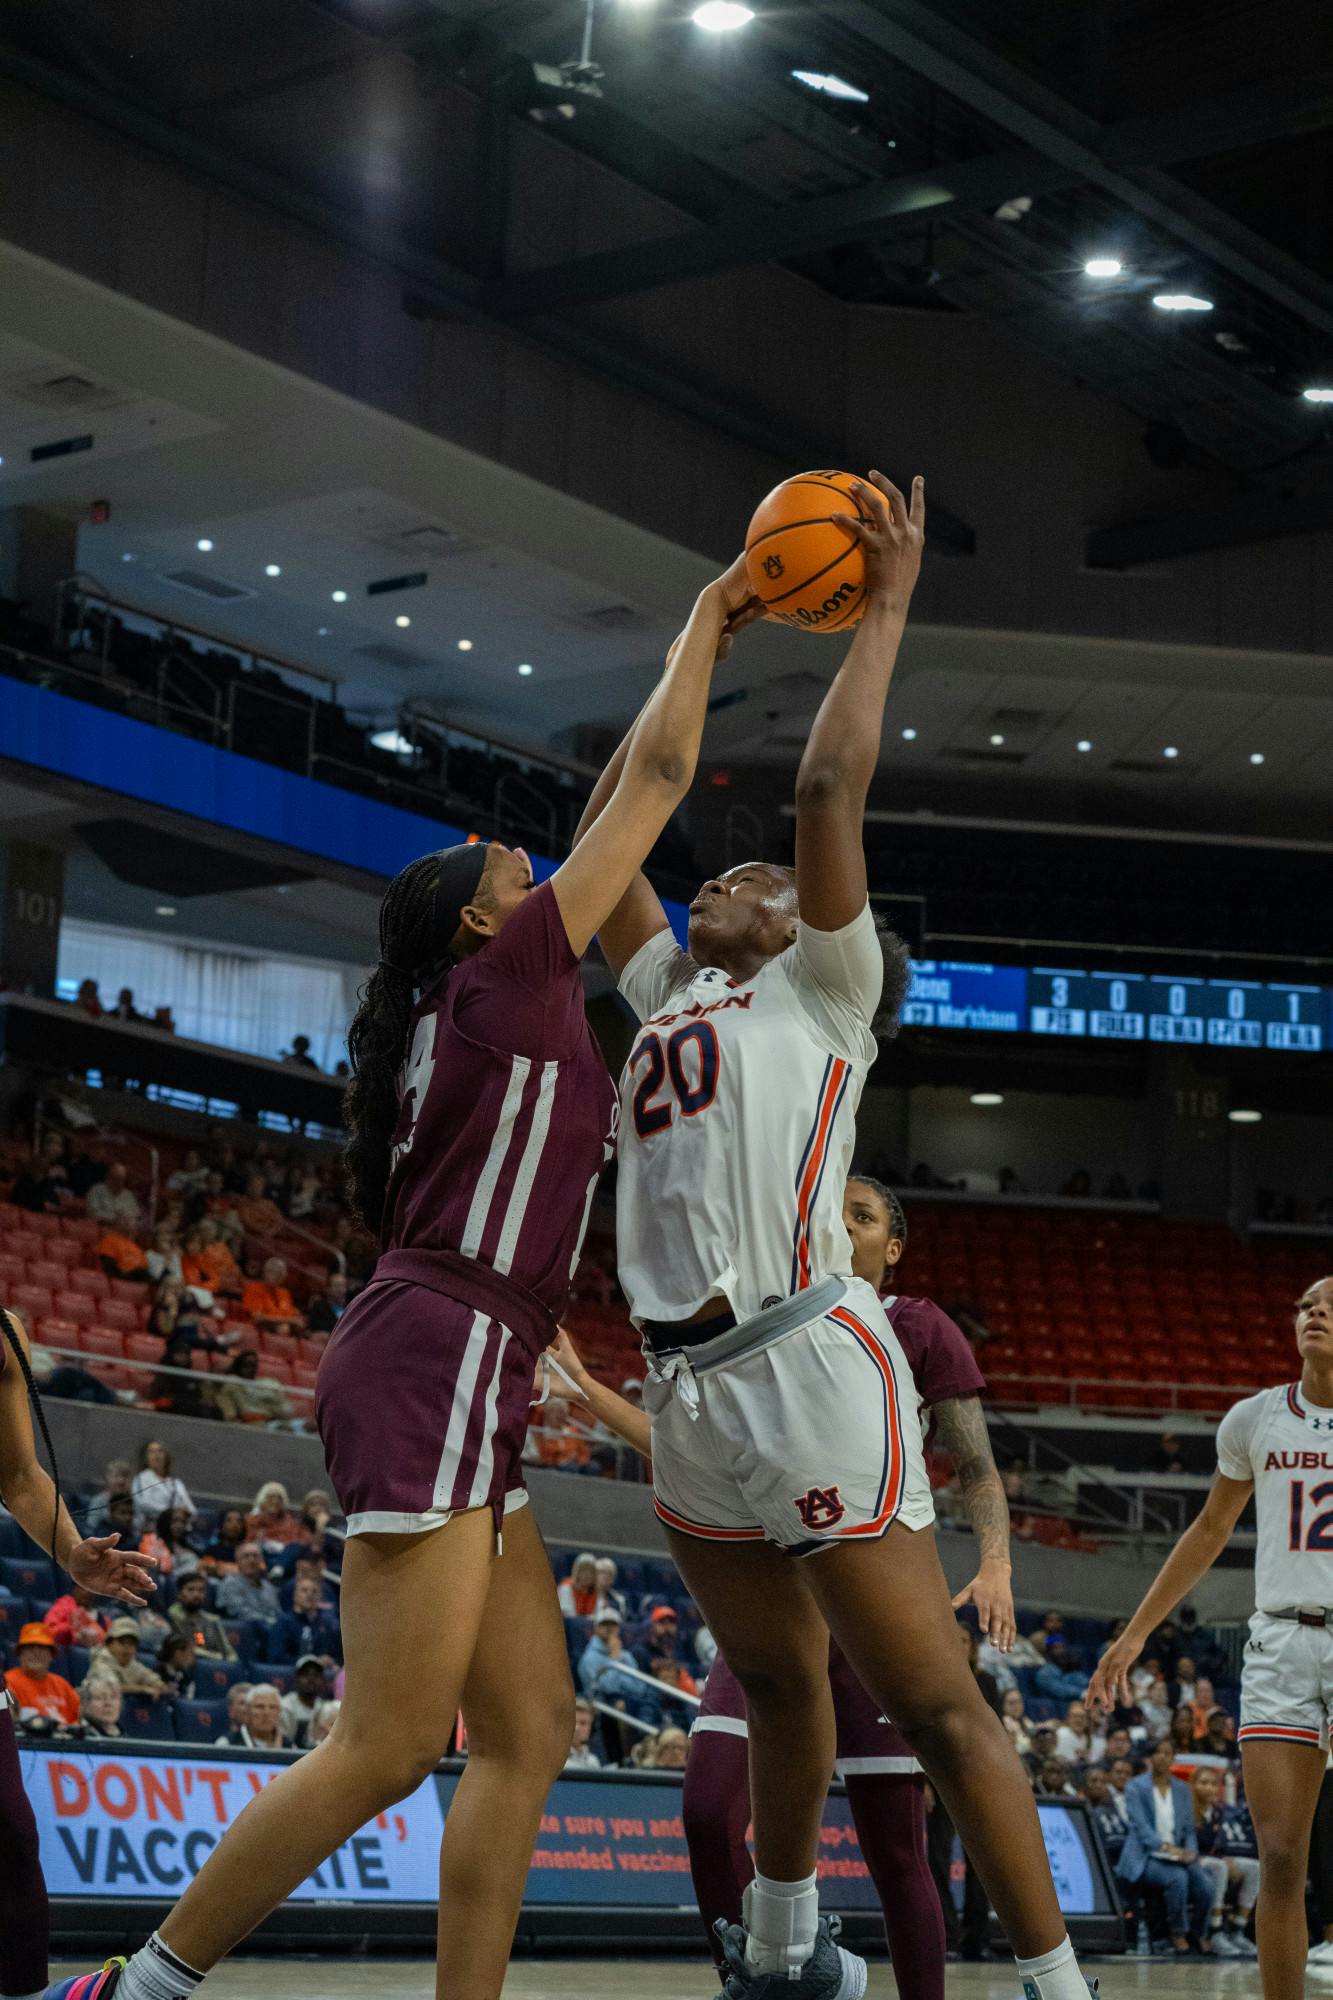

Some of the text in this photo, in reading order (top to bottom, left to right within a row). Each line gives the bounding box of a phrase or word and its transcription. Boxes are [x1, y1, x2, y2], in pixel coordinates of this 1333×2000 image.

[1052, 976, 1299, 1022] 3 0 0 0 1
[628, 1019, 720, 1140] 20
[1289, 1480, 1333, 1552] 12
[47, 1761, 231, 1823] DON'T
[56, 1826, 390, 1889] VACCTE
[531, 1846, 614, 1871] mended
[609, 1818, 645, 1840] you
